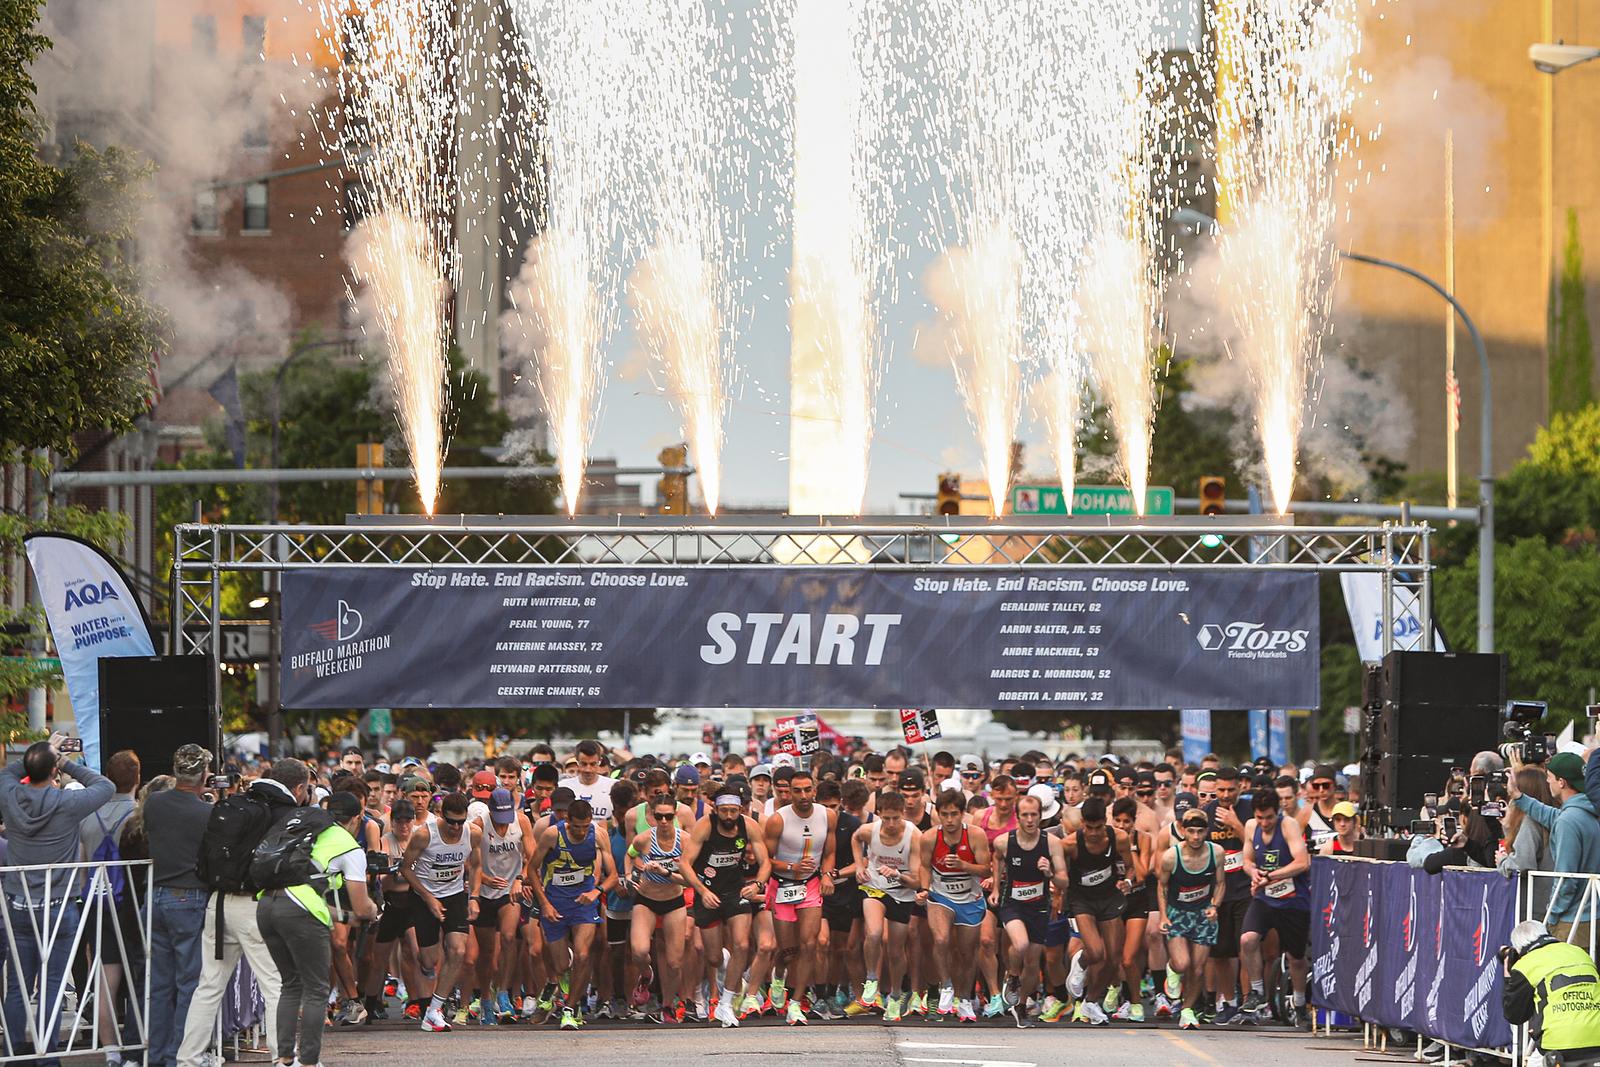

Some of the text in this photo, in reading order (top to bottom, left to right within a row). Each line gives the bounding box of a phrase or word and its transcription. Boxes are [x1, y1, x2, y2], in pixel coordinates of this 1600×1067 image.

[411, 572, 689, 589] Stop Hate. End Racism. Choose Love.
[913, 577, 1190, 594] Stop Hate. End Racism. Choose Love.
[65, 581, 119, 612] AQA
[502, 598, 596, 607] RUTH WHITFIELD, 86
[1000, 603, 1102, 612] GERALDINE TALLEY, 62
[71, 616, 110, 637] WATER
[509, 620, 590, 629] PEARL YOUNG, 77
[1000, 625, 1102, 634] AARON SALTER, JR. 55
[74, 626, 132, 650] PURPOSE.
[699, 611, 903, 666] START
[291, 634, 391, 670] BUFFALO MARATHON
[496, 642, 603, 651] KATHERINE MASSEY, 72
[1002, 647, 1099, 657] ANDRE MACKNEIL, 53
[1228, 650, 1288, 660] Friendly Markets
[316, 655, 363, 679] WEEKEND
[490, 664, 608, 674] HEYWARD PATTERSON, 67
[1032, 669, 1042, 678] D.
[1044, 669, 1096, 679] MORRISON,
[1098, 669, 1111, 678] 52
[497, 686, 600, 696] CELESTINE CHANEY, 65
[998, 691, 1104, 702] ROBERTA A. DRURY, 32
[801, 740, 820, 755] 3:20
[435, 852, 464, 863] BUFFALO
[945, 882, 965, 891] 1211
[1562, 991, 1594, 1002] OFFICIAL
[1552, 1002, 1600, 1014] PHOTOGRAPHE
